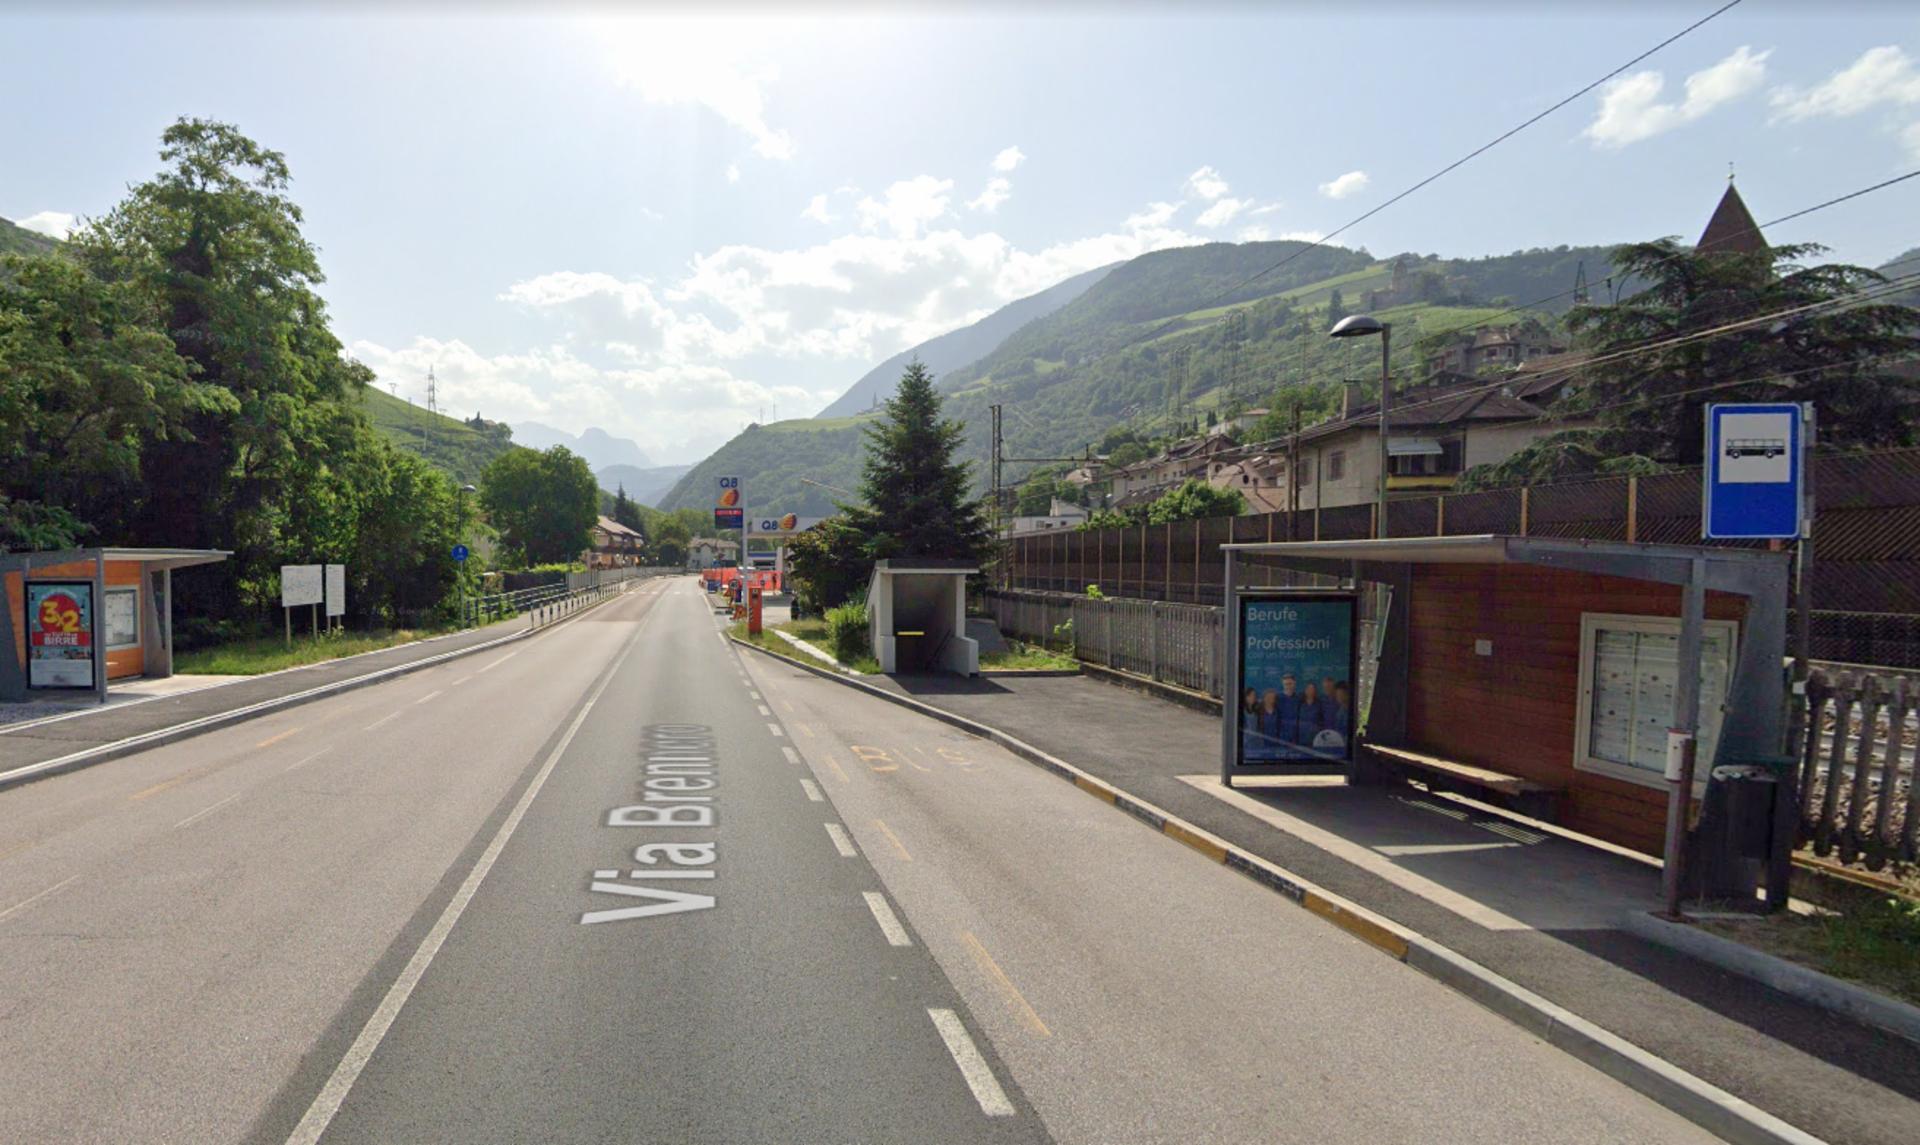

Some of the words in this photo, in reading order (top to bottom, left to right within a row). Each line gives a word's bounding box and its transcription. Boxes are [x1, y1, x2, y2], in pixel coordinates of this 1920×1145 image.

[720, 477, 738, 488] Q8
[761, 520, 778, 530] Q8
[41, 600, 80, 632] 3x2
[1248, 607, 1298, 621] Berufe
[44, 636, 78, 646] BIRRE
[1248, 635, 1330, 650] Professioni
